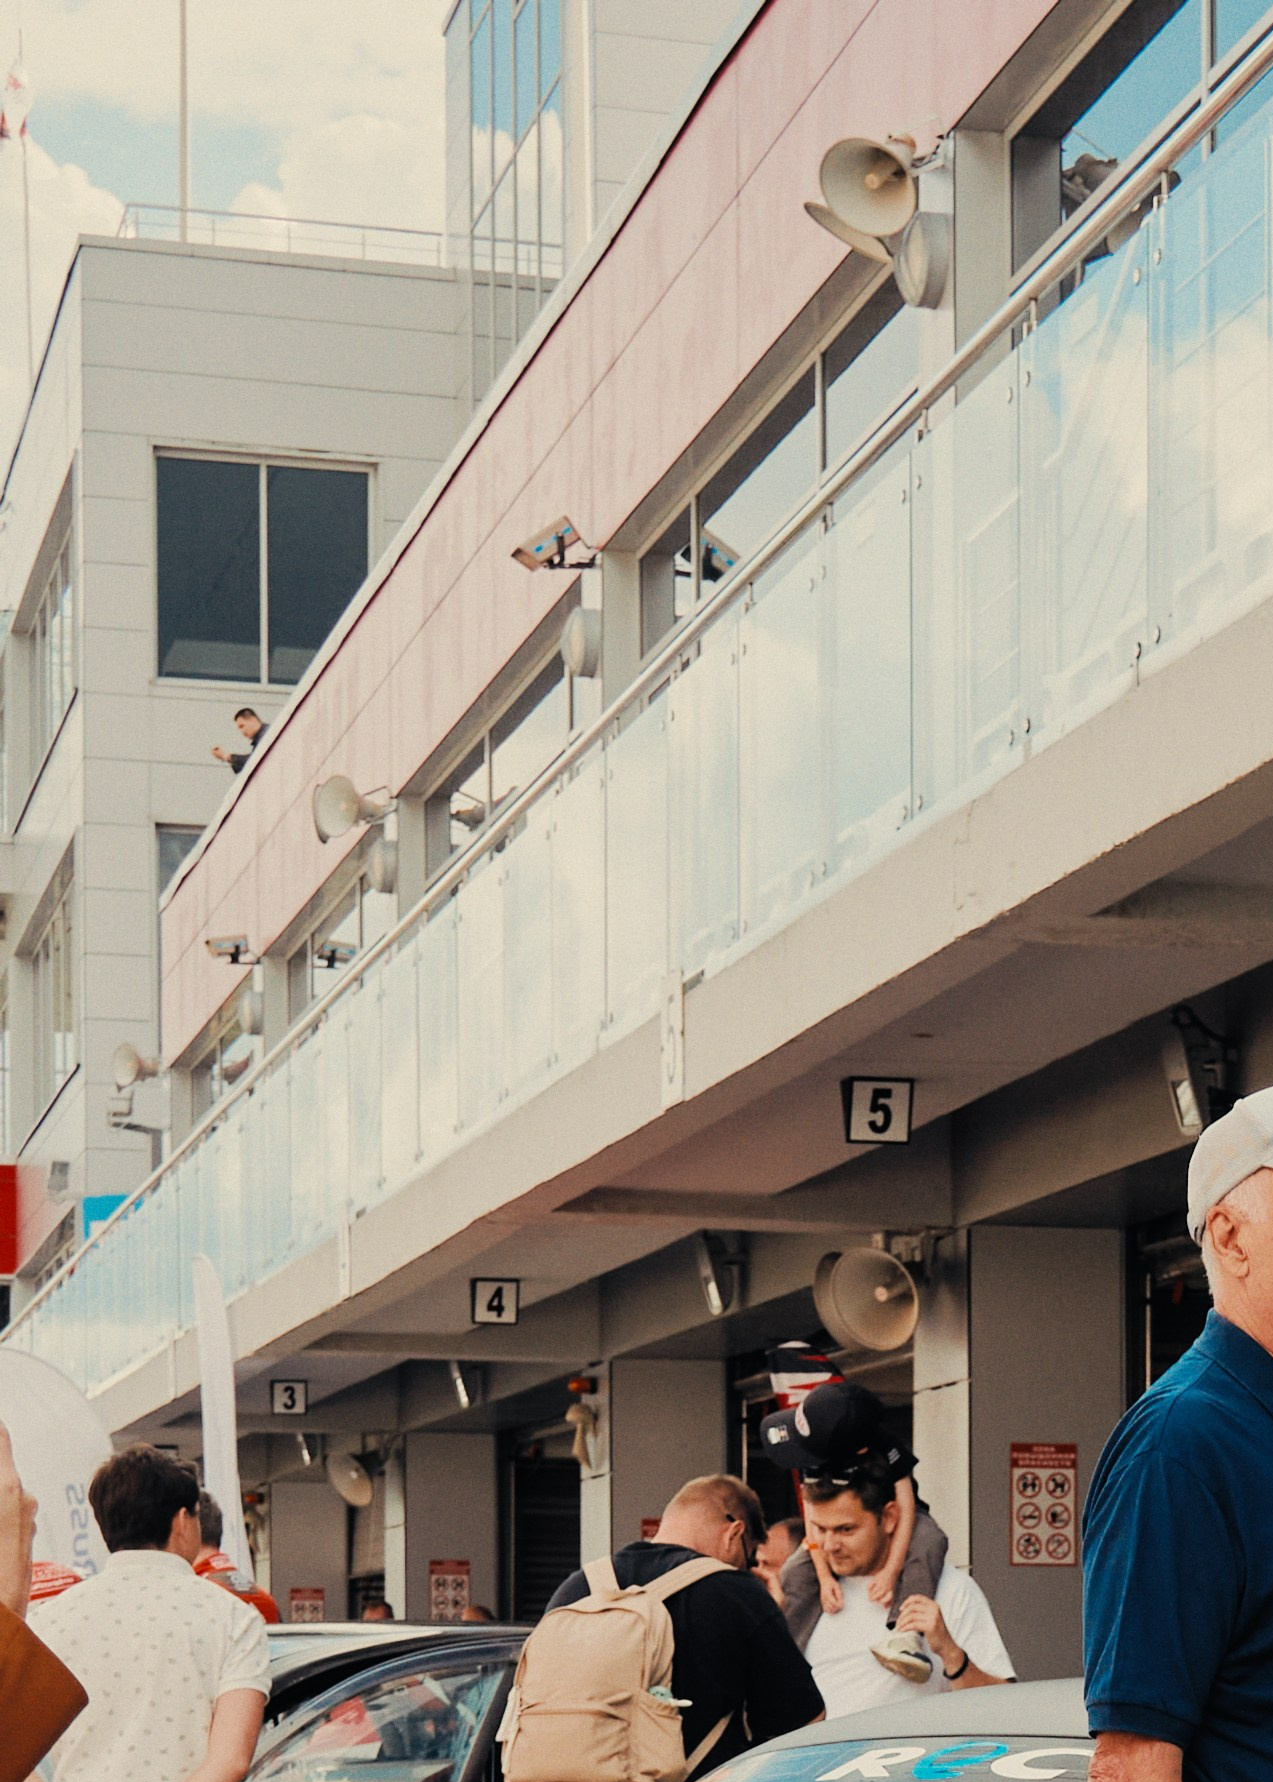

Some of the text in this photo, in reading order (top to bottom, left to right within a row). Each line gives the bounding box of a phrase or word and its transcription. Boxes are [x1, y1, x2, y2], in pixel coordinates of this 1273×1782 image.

[867, 1088, 893, 1134] 5
[486, 1286, 505, 1318] 4
[283, 1385, 296, 1410] 3
